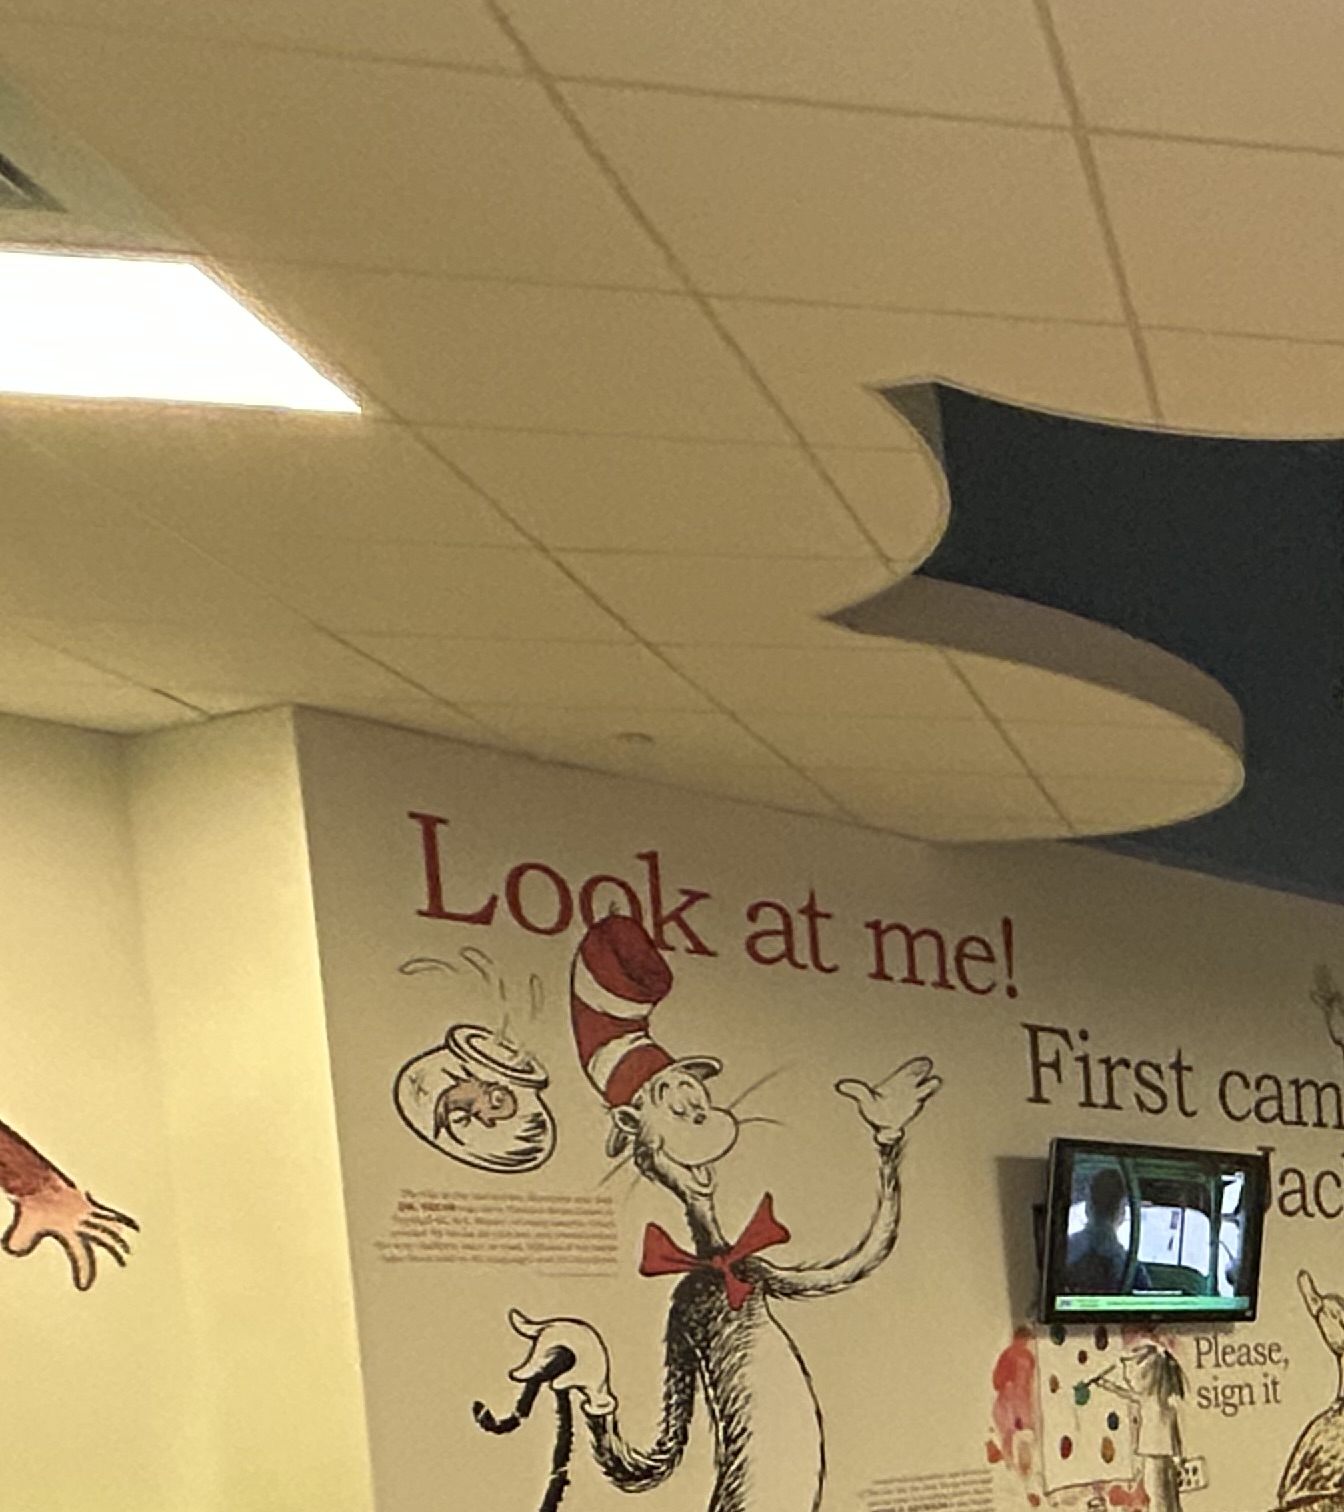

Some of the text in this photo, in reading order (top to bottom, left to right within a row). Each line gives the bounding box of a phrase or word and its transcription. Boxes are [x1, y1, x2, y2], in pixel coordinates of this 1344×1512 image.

[408, 811, 1019, 999] Look at me!
[1021, 1022, 1198, 1118] First
[1193, 1331, 1289, 1371] Please,
[1196, 1372, 1281, 1417] sign it
